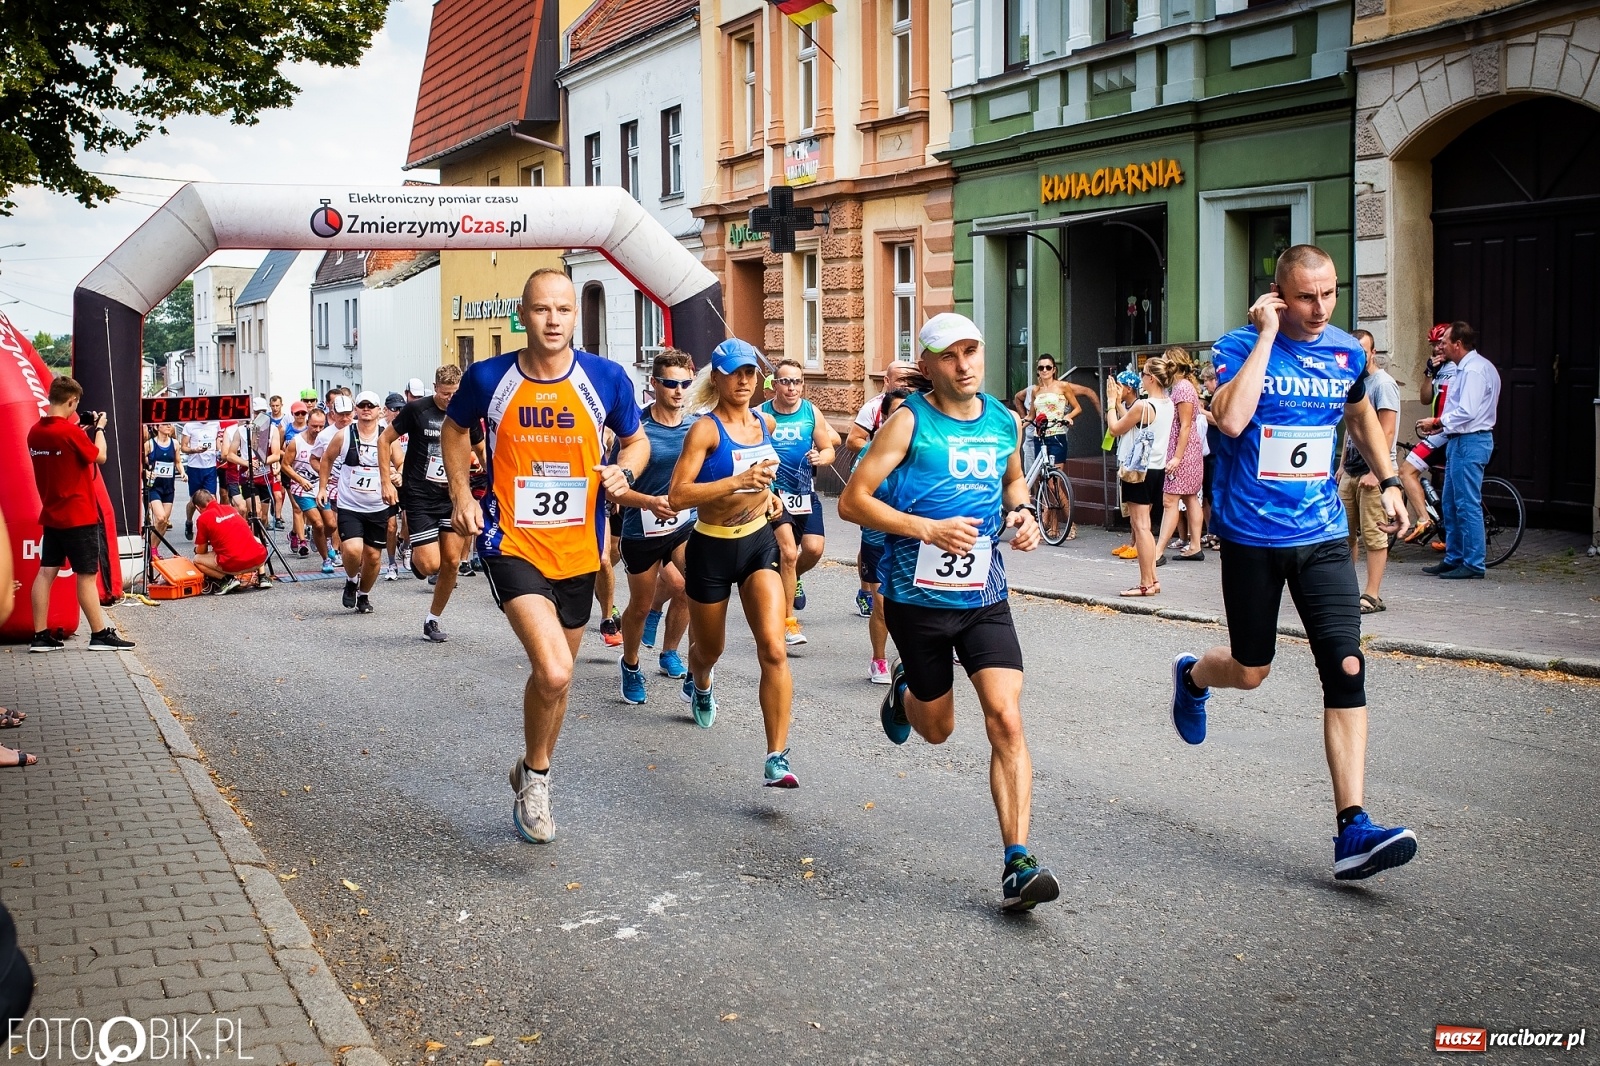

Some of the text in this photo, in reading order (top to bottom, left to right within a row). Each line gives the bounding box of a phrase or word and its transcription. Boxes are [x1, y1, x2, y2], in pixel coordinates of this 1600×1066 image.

[1040, 158, 1184, 204] KWIACIARNIA
[348, 193, 519, 207] Elektroniczny pomiar czasu
[346, 214, 528, 238] ZmierzymyCzas.pl
[464, 302, 482, 319] BANK
[151, 396, 250, 422] 0 00 04
[519, 406, 554, 429] ULC
[513, 434, 583, 444] LANGENLOIS
[948, 447, 999, 480] bbl
[1290, 442, 1308, 469] 6
[435, 465, 446, 477] 5
[356, 477, 372, 489] 41
[532, 490, 570, 517] 38
[787, 495, 803, 509] 30
[935, 552, 976, 579] 33
